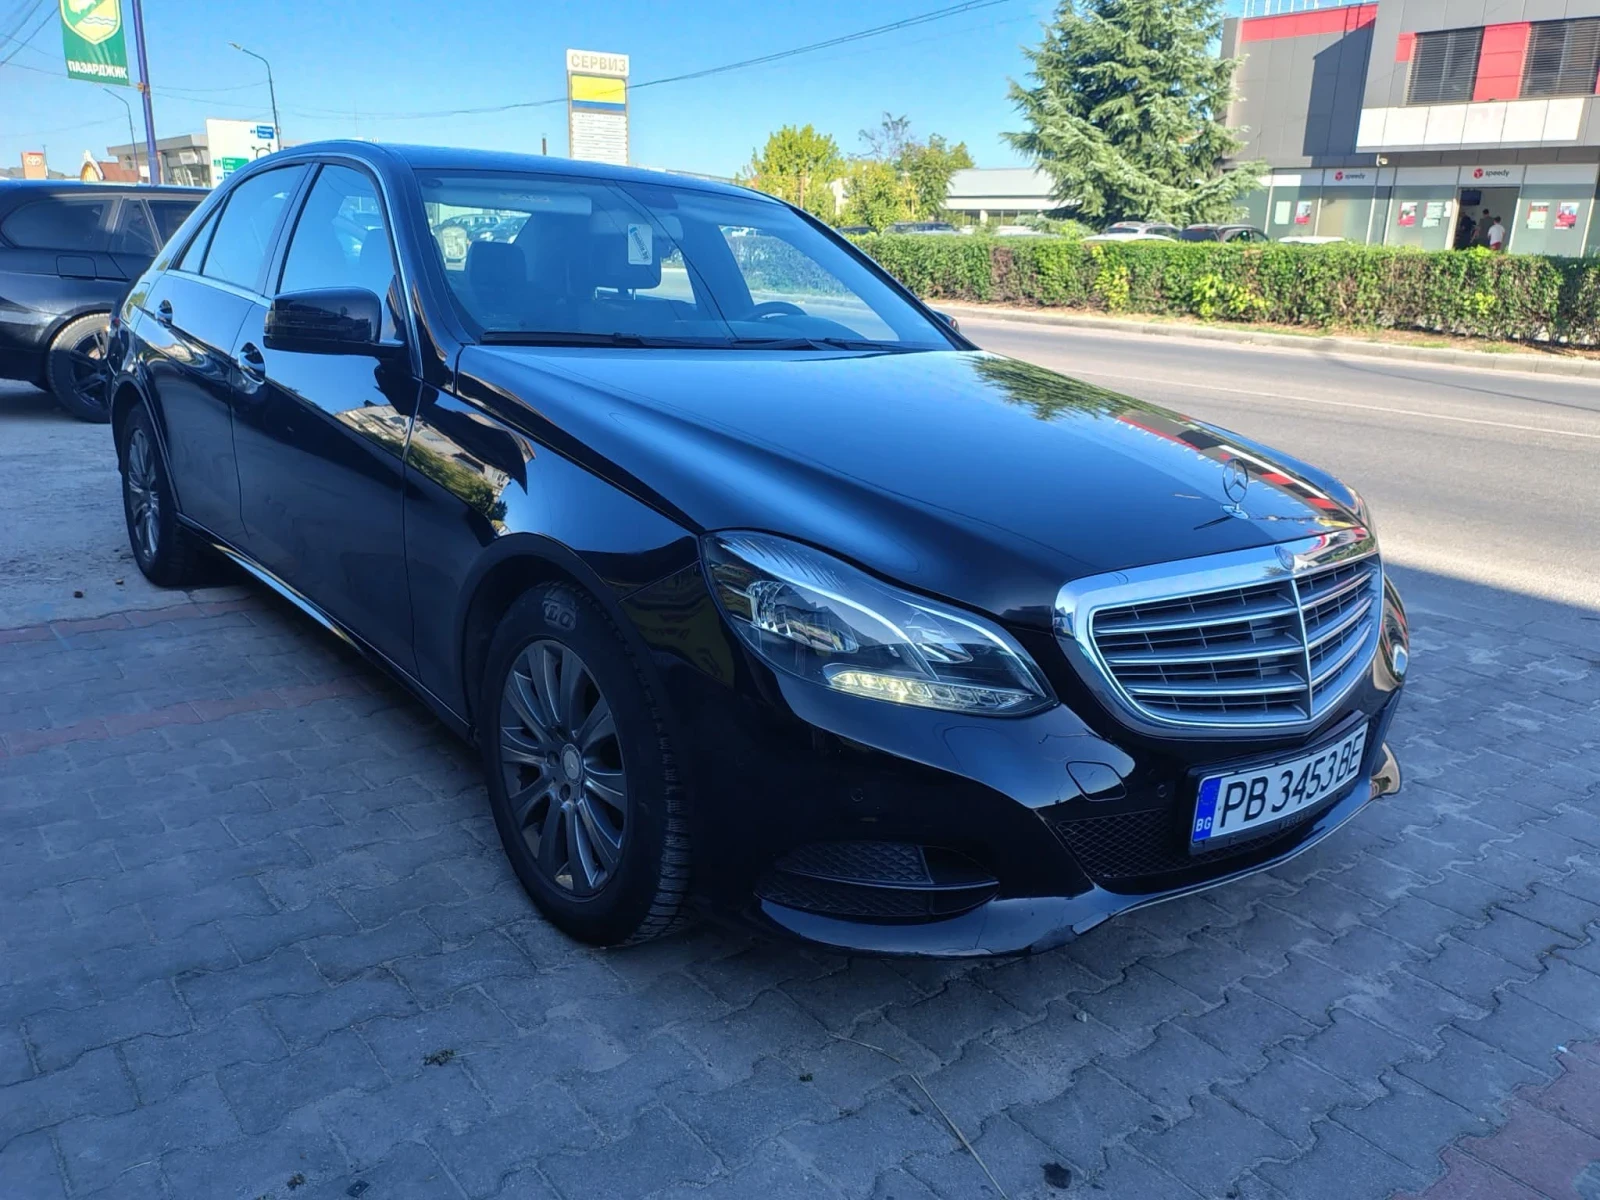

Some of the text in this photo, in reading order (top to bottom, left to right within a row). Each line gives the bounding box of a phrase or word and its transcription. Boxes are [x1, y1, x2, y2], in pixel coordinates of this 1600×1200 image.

[68, 60, 128, 79] ПАЗАРДЖИК
[571, 53, 626, 72] СЕРВИЗ
[1485, 169, 1509, 178] speedy
[1271, 750, 1338, 813] 3453
[1195, 817, 1212, 833] BG
